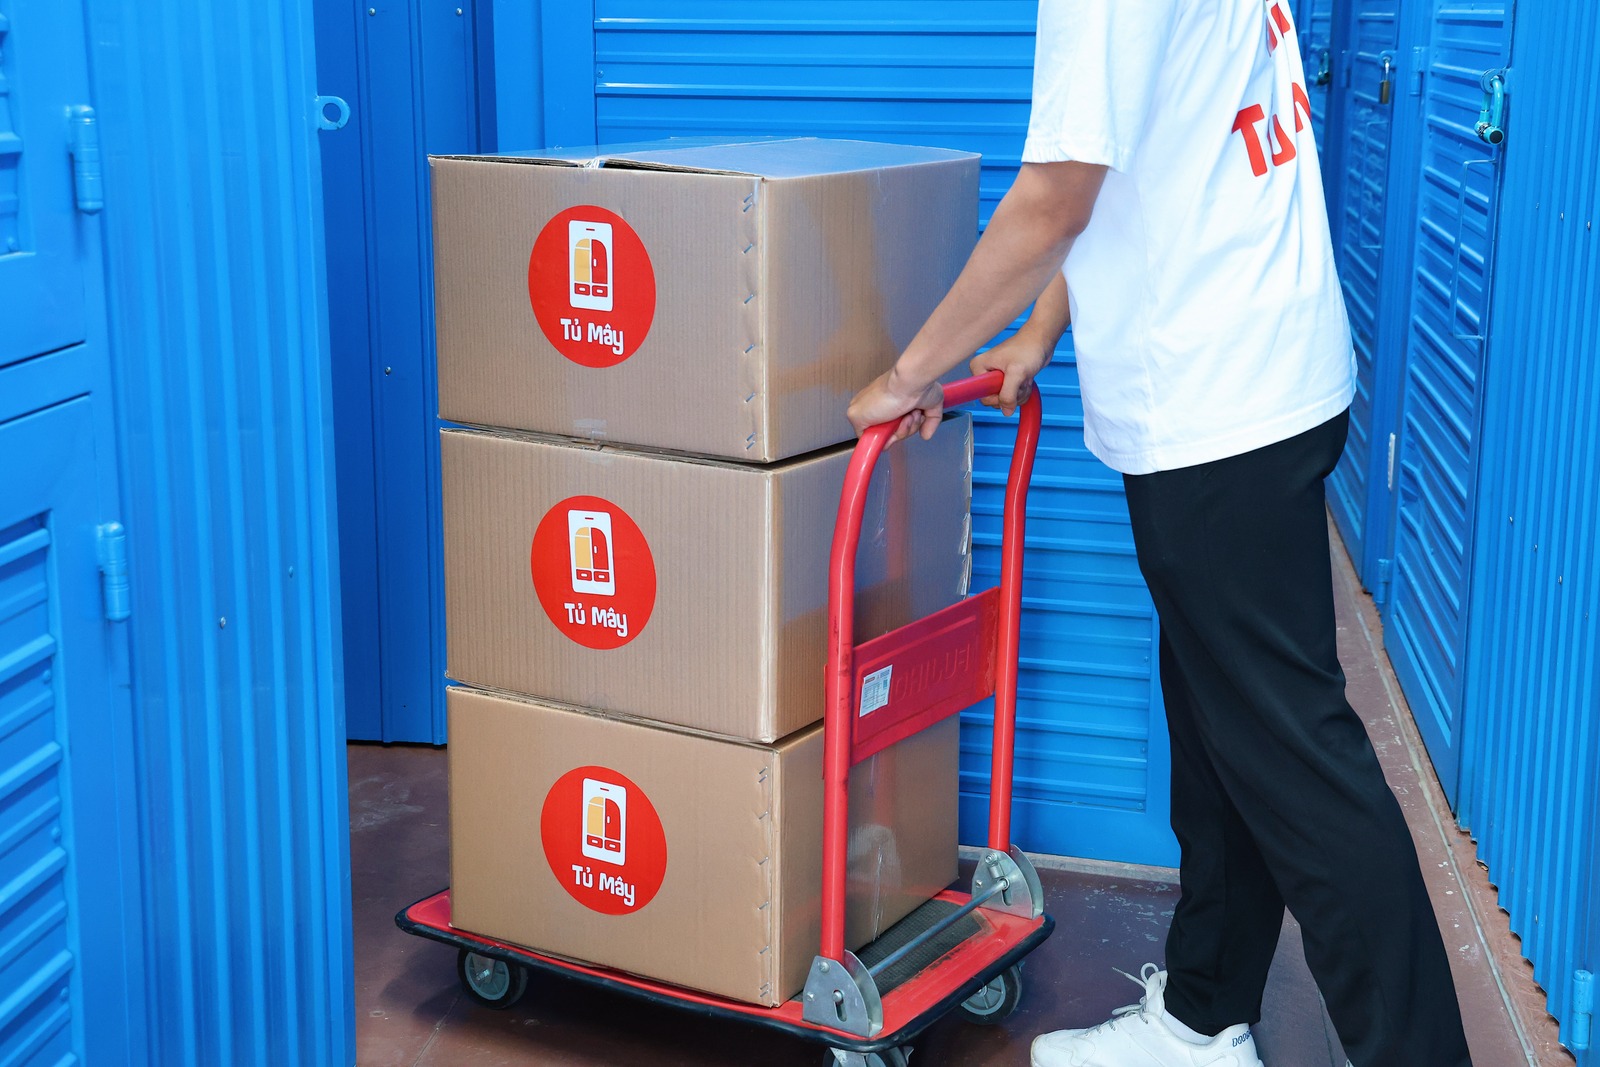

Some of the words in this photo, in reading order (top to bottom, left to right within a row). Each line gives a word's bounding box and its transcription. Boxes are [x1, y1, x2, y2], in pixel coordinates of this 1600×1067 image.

[560, 317, 582, 342] Tủ
[587, 322, 624, 356] Mây
[564, 602, 586, 625] Tủ
[591, 606, 628, 638] Mây
[571, 864, 593, 888] Tủ
[599, 872, 635, 907] Mây
